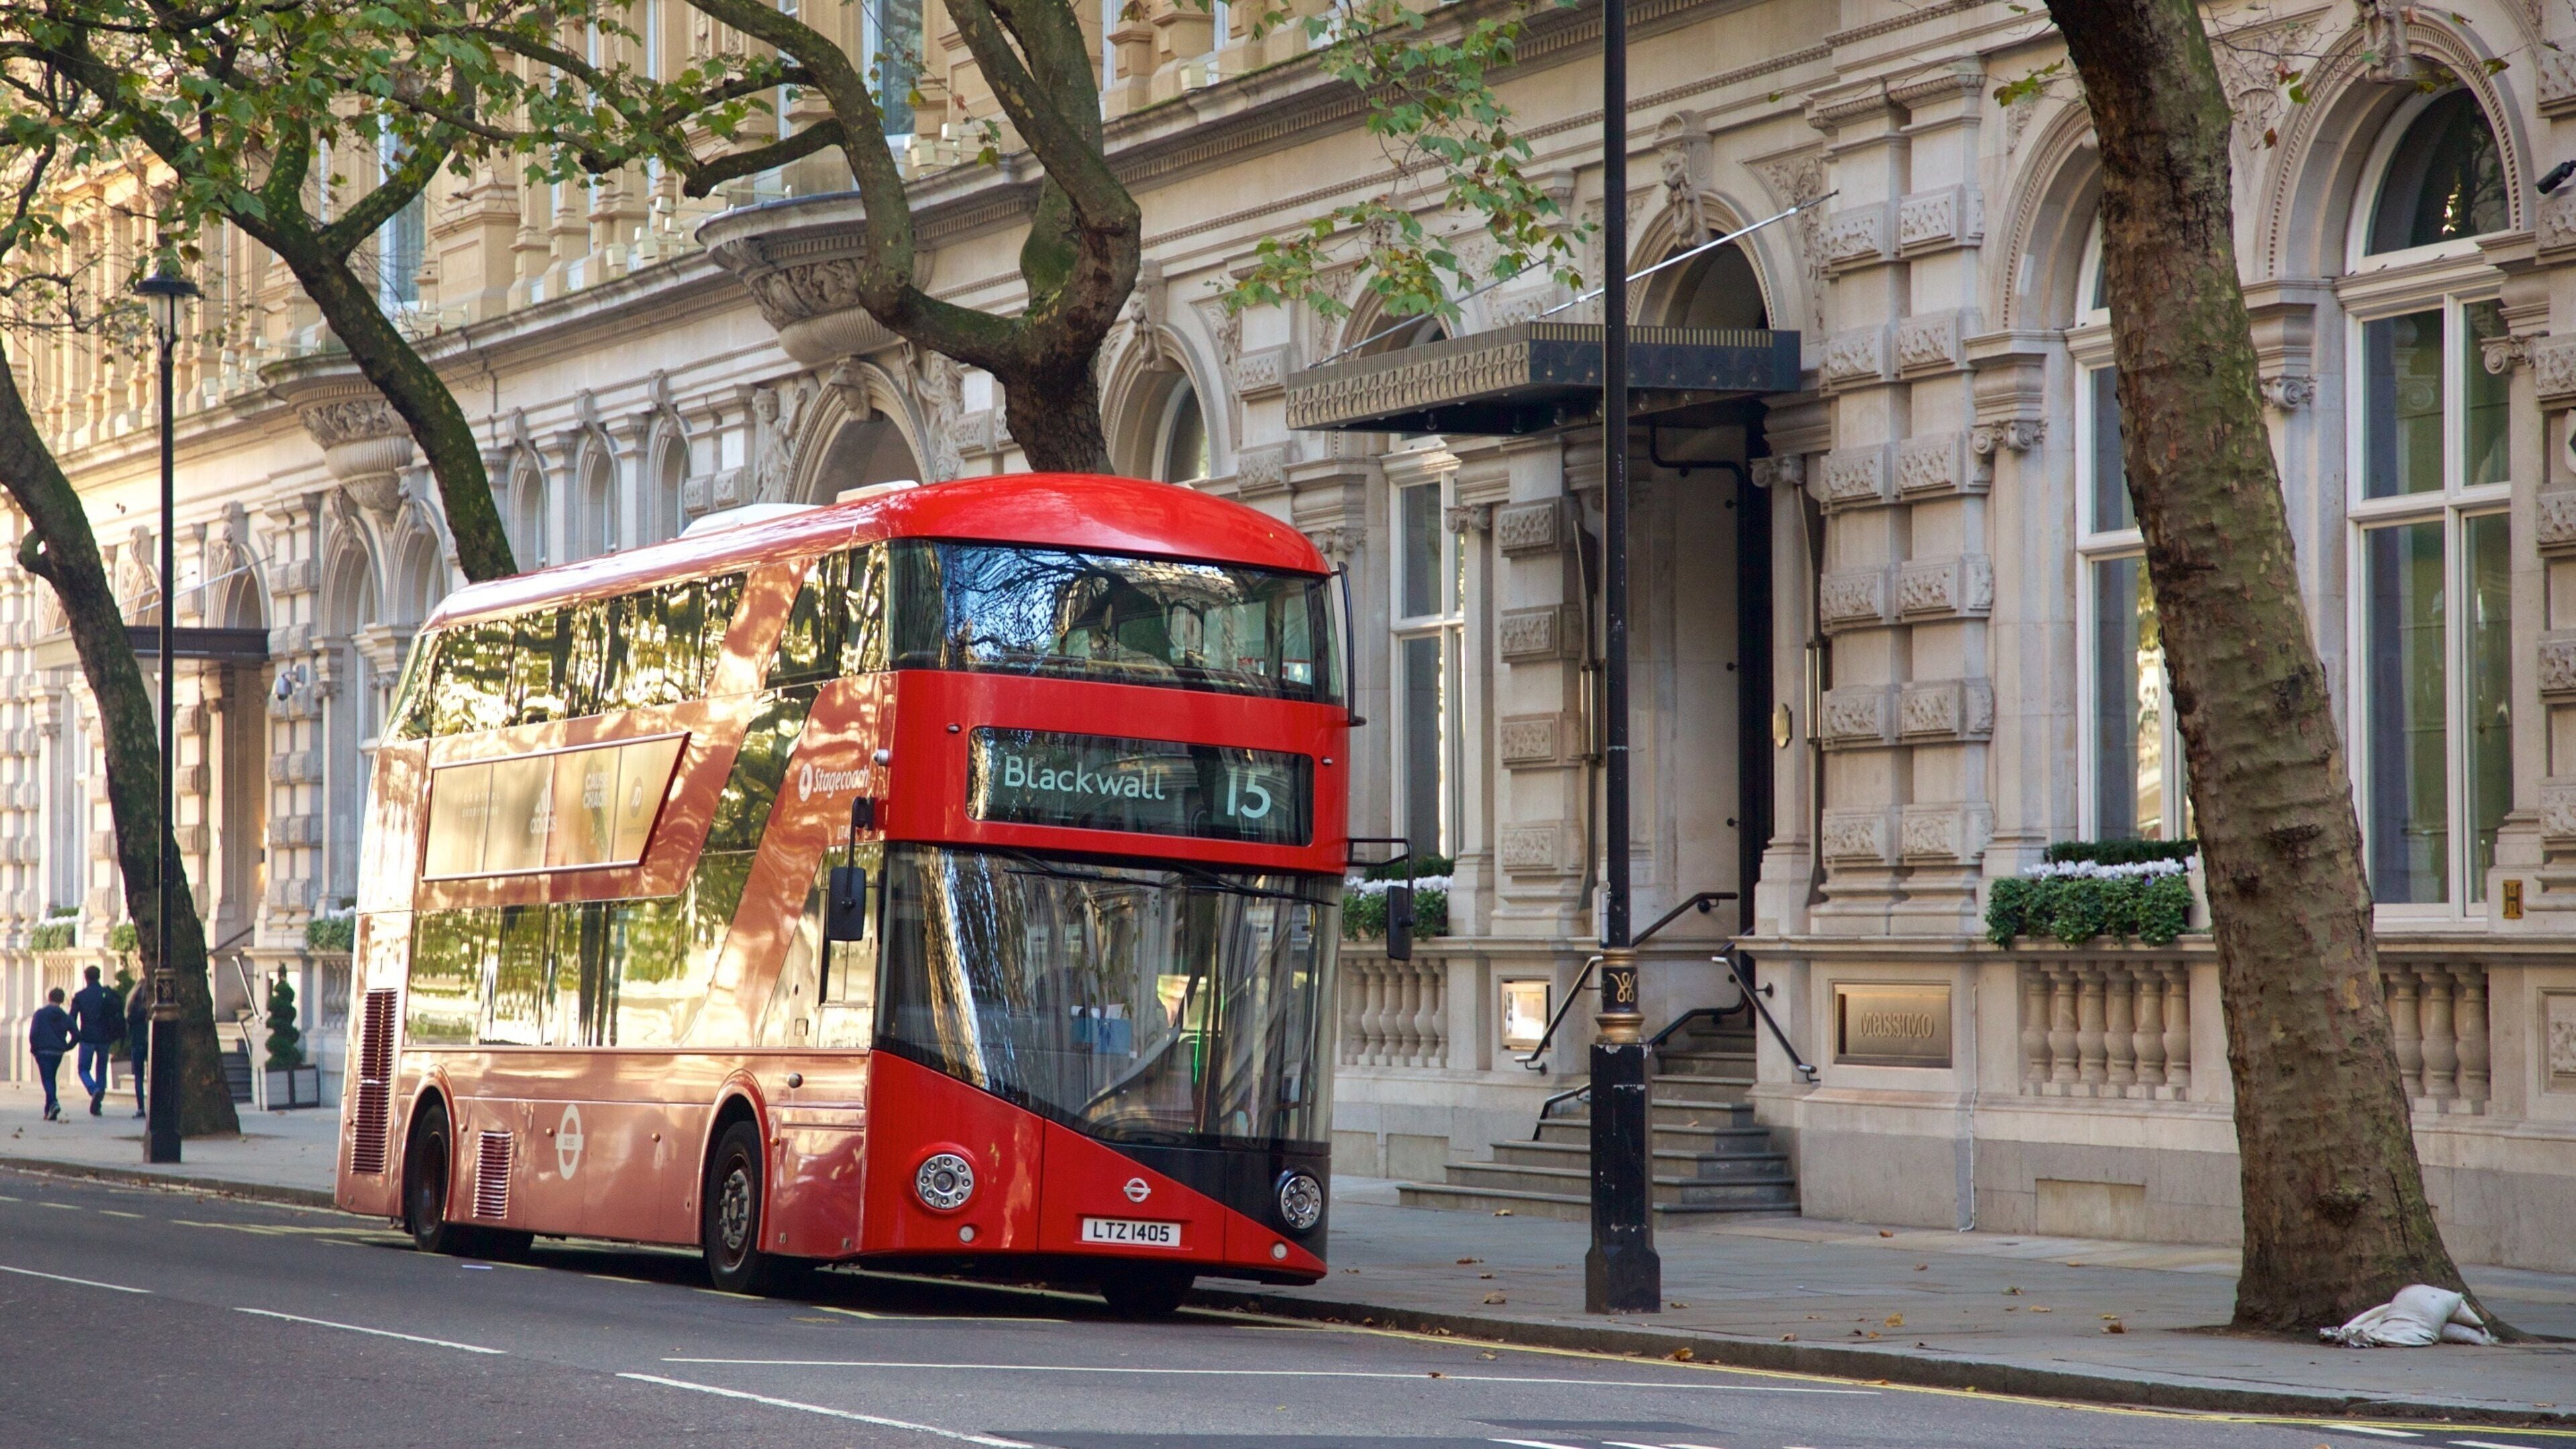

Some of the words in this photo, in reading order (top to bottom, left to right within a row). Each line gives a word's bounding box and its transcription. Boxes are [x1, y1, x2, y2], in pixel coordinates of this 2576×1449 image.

[813, 765, 869, 799] Stagecoach
[1004, 755, 1165, 800] Blackwall
[1227, 765, 1273, 818] 15
[1093, 1221, 1127, 1240] LTZ
[1131, 1224, 1170, 1242] 1405
